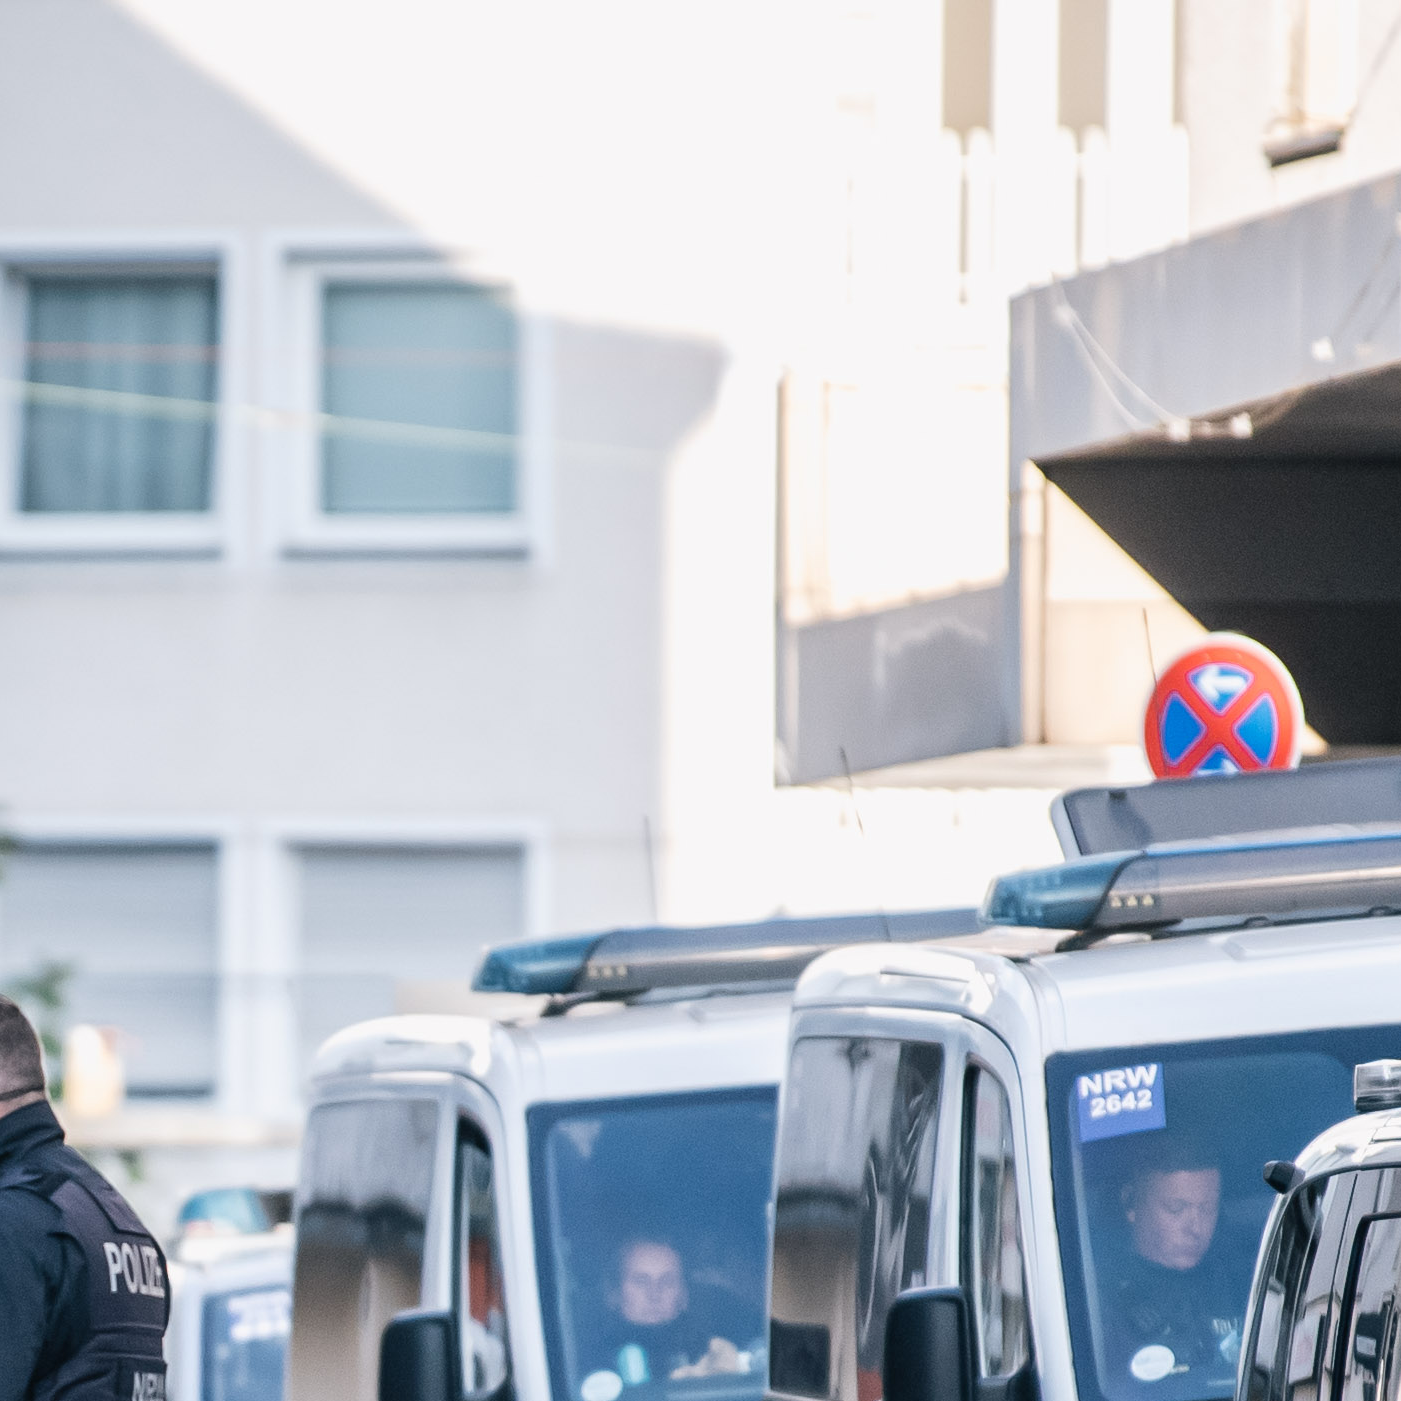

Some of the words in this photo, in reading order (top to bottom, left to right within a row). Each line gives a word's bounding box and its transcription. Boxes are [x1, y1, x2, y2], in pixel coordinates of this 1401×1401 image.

[1080, 1063, 1158, 1098] NRW
[1090, 1089, 1153, 1118] 2642
[103, 1242, 165, 1298] POLIZE
